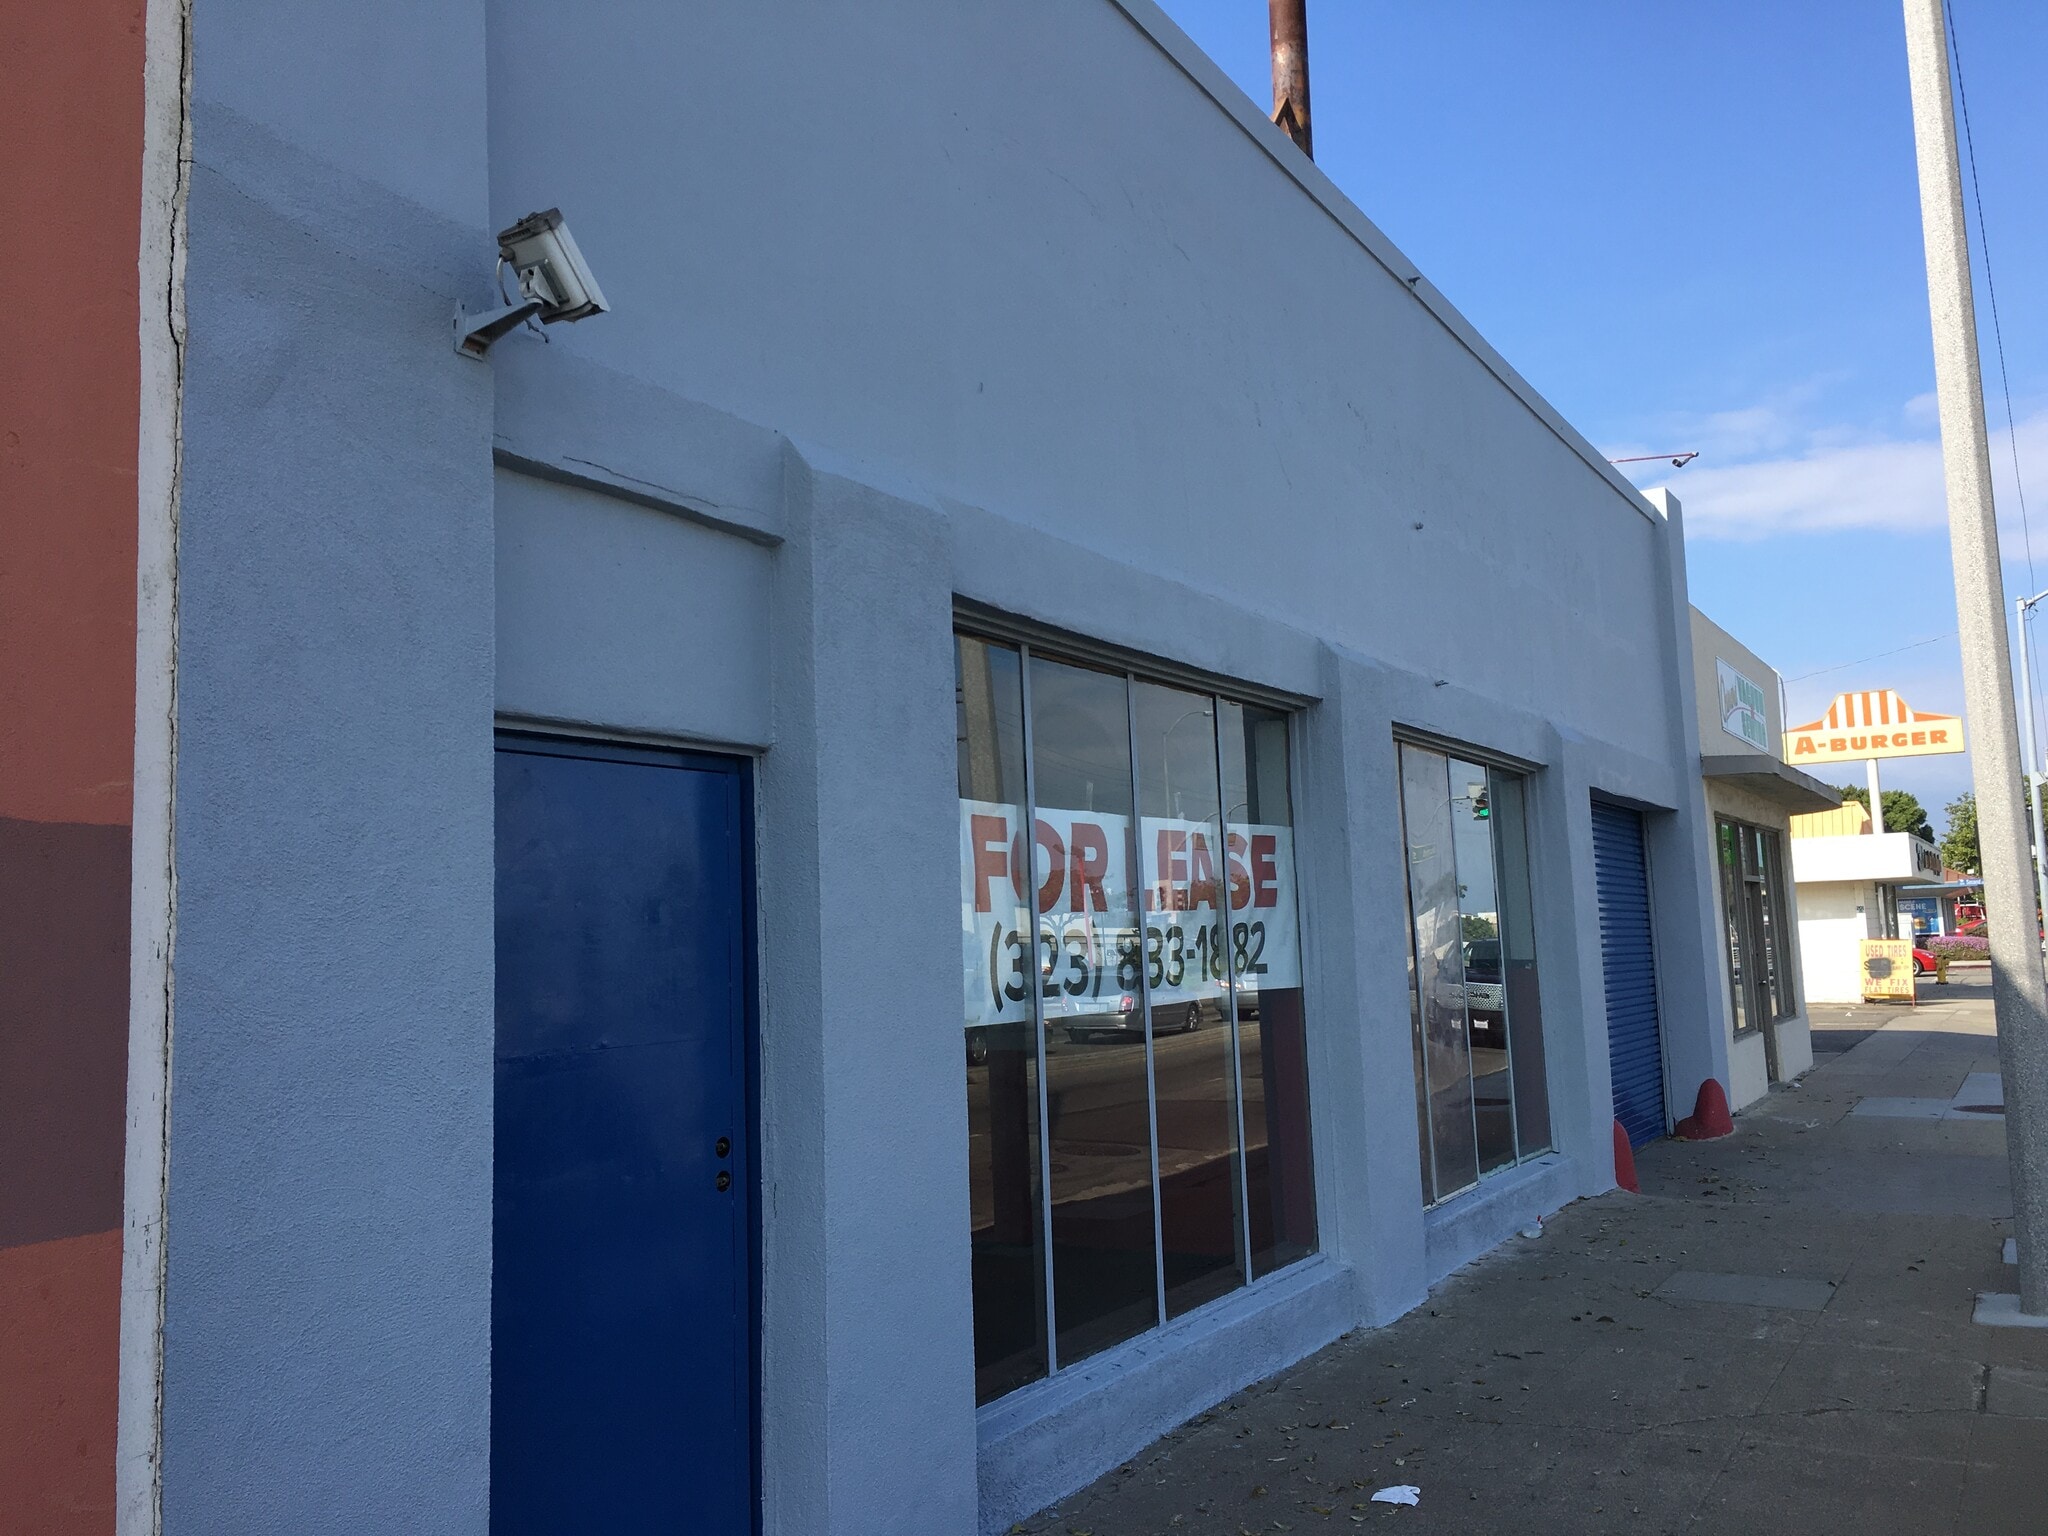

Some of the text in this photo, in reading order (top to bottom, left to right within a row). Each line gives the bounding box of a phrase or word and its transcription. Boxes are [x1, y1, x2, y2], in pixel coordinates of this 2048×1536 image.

[1794, 730, 1948, 755] A-BURGER
[970, 813, 1109, 914] FOR
[1865, 944, 1908, 958] USED TIRES
[1865, 978, 1908, 987] WE FIX
[1887, 986, 1910, 994] TIRES
